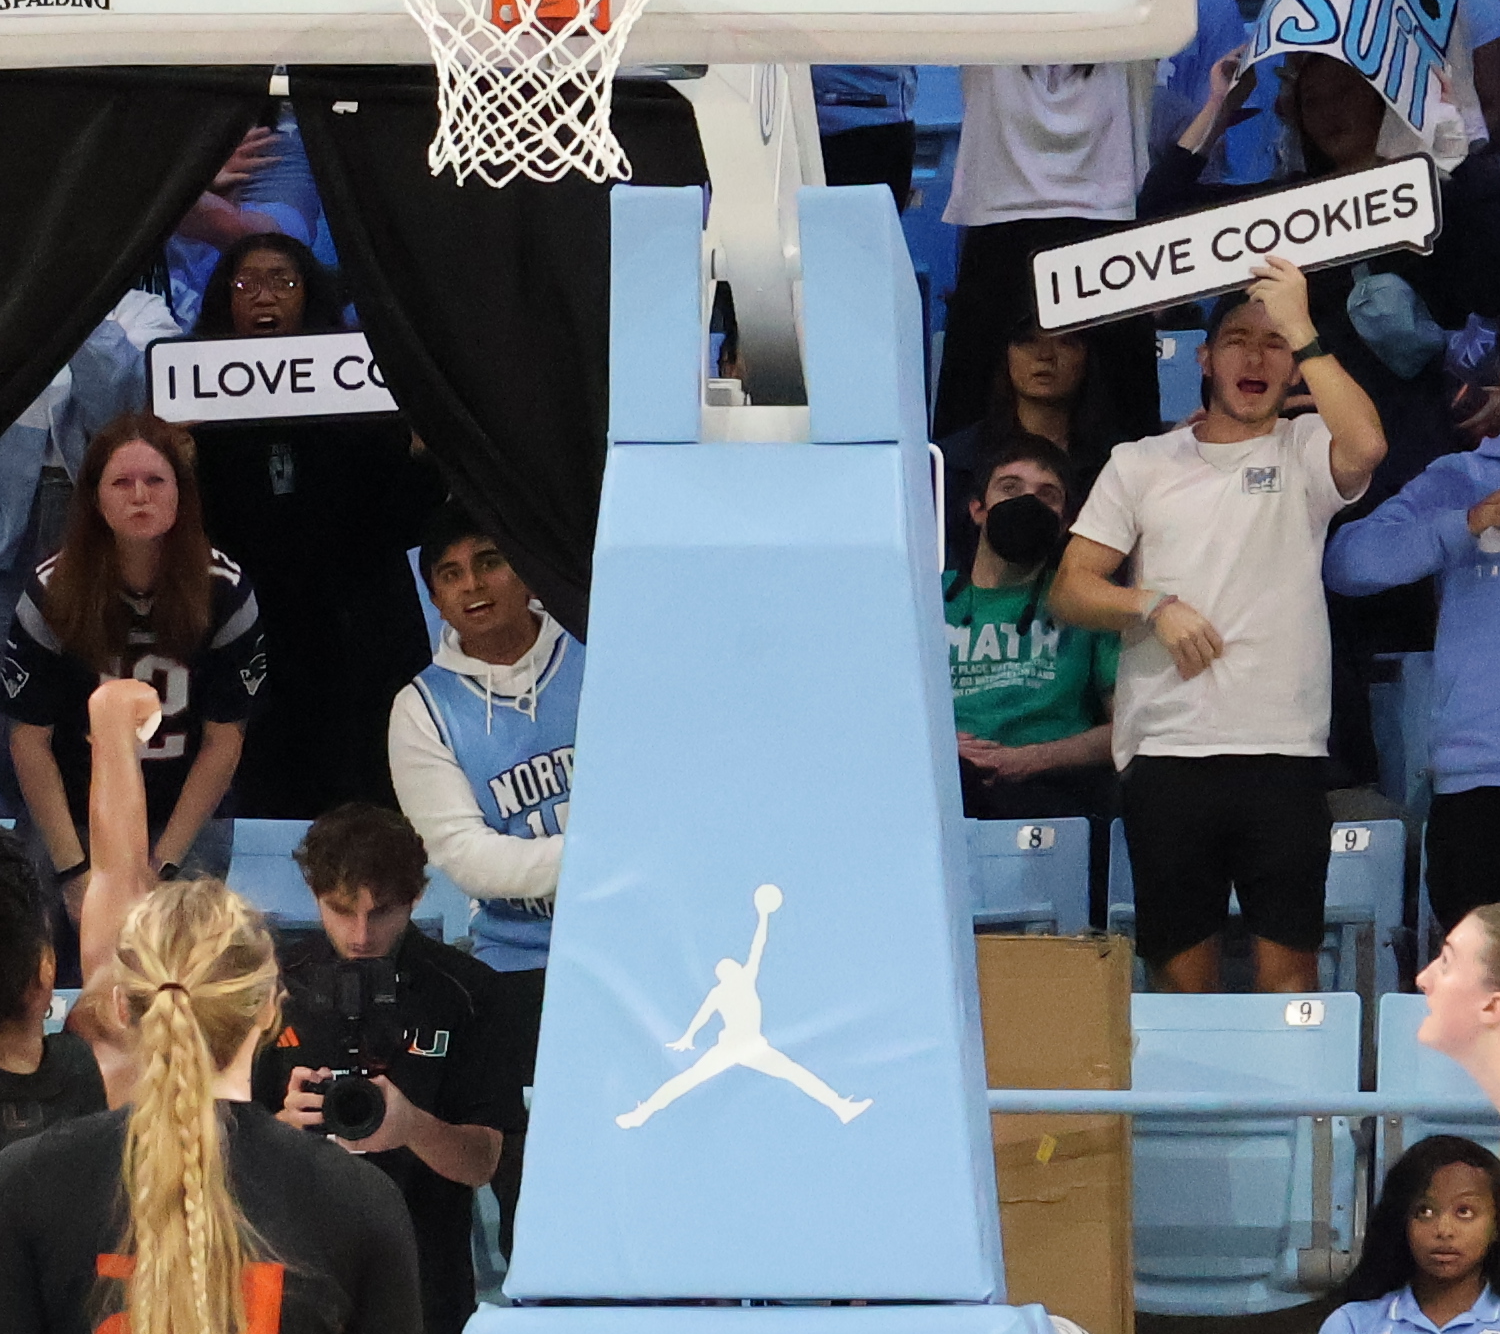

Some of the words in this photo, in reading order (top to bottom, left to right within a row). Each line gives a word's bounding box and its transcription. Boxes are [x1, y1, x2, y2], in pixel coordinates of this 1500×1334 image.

[1050, 270, 1061, 305] I
[1075, 237, 1197, 299] LOVE
[1210, 182, 1420, 263] COOKIES
[168, 365, 177, 400] I
[193, 358, 317, 399] LOVE
[948, 619, 1061, 663] MATH
[489, 745, 575, 819] NORT
[1029, 826, 1043, 849] 8
[1345, 829, 1357, 851] 9
[1300, 1002, 1313, 1023] 9
